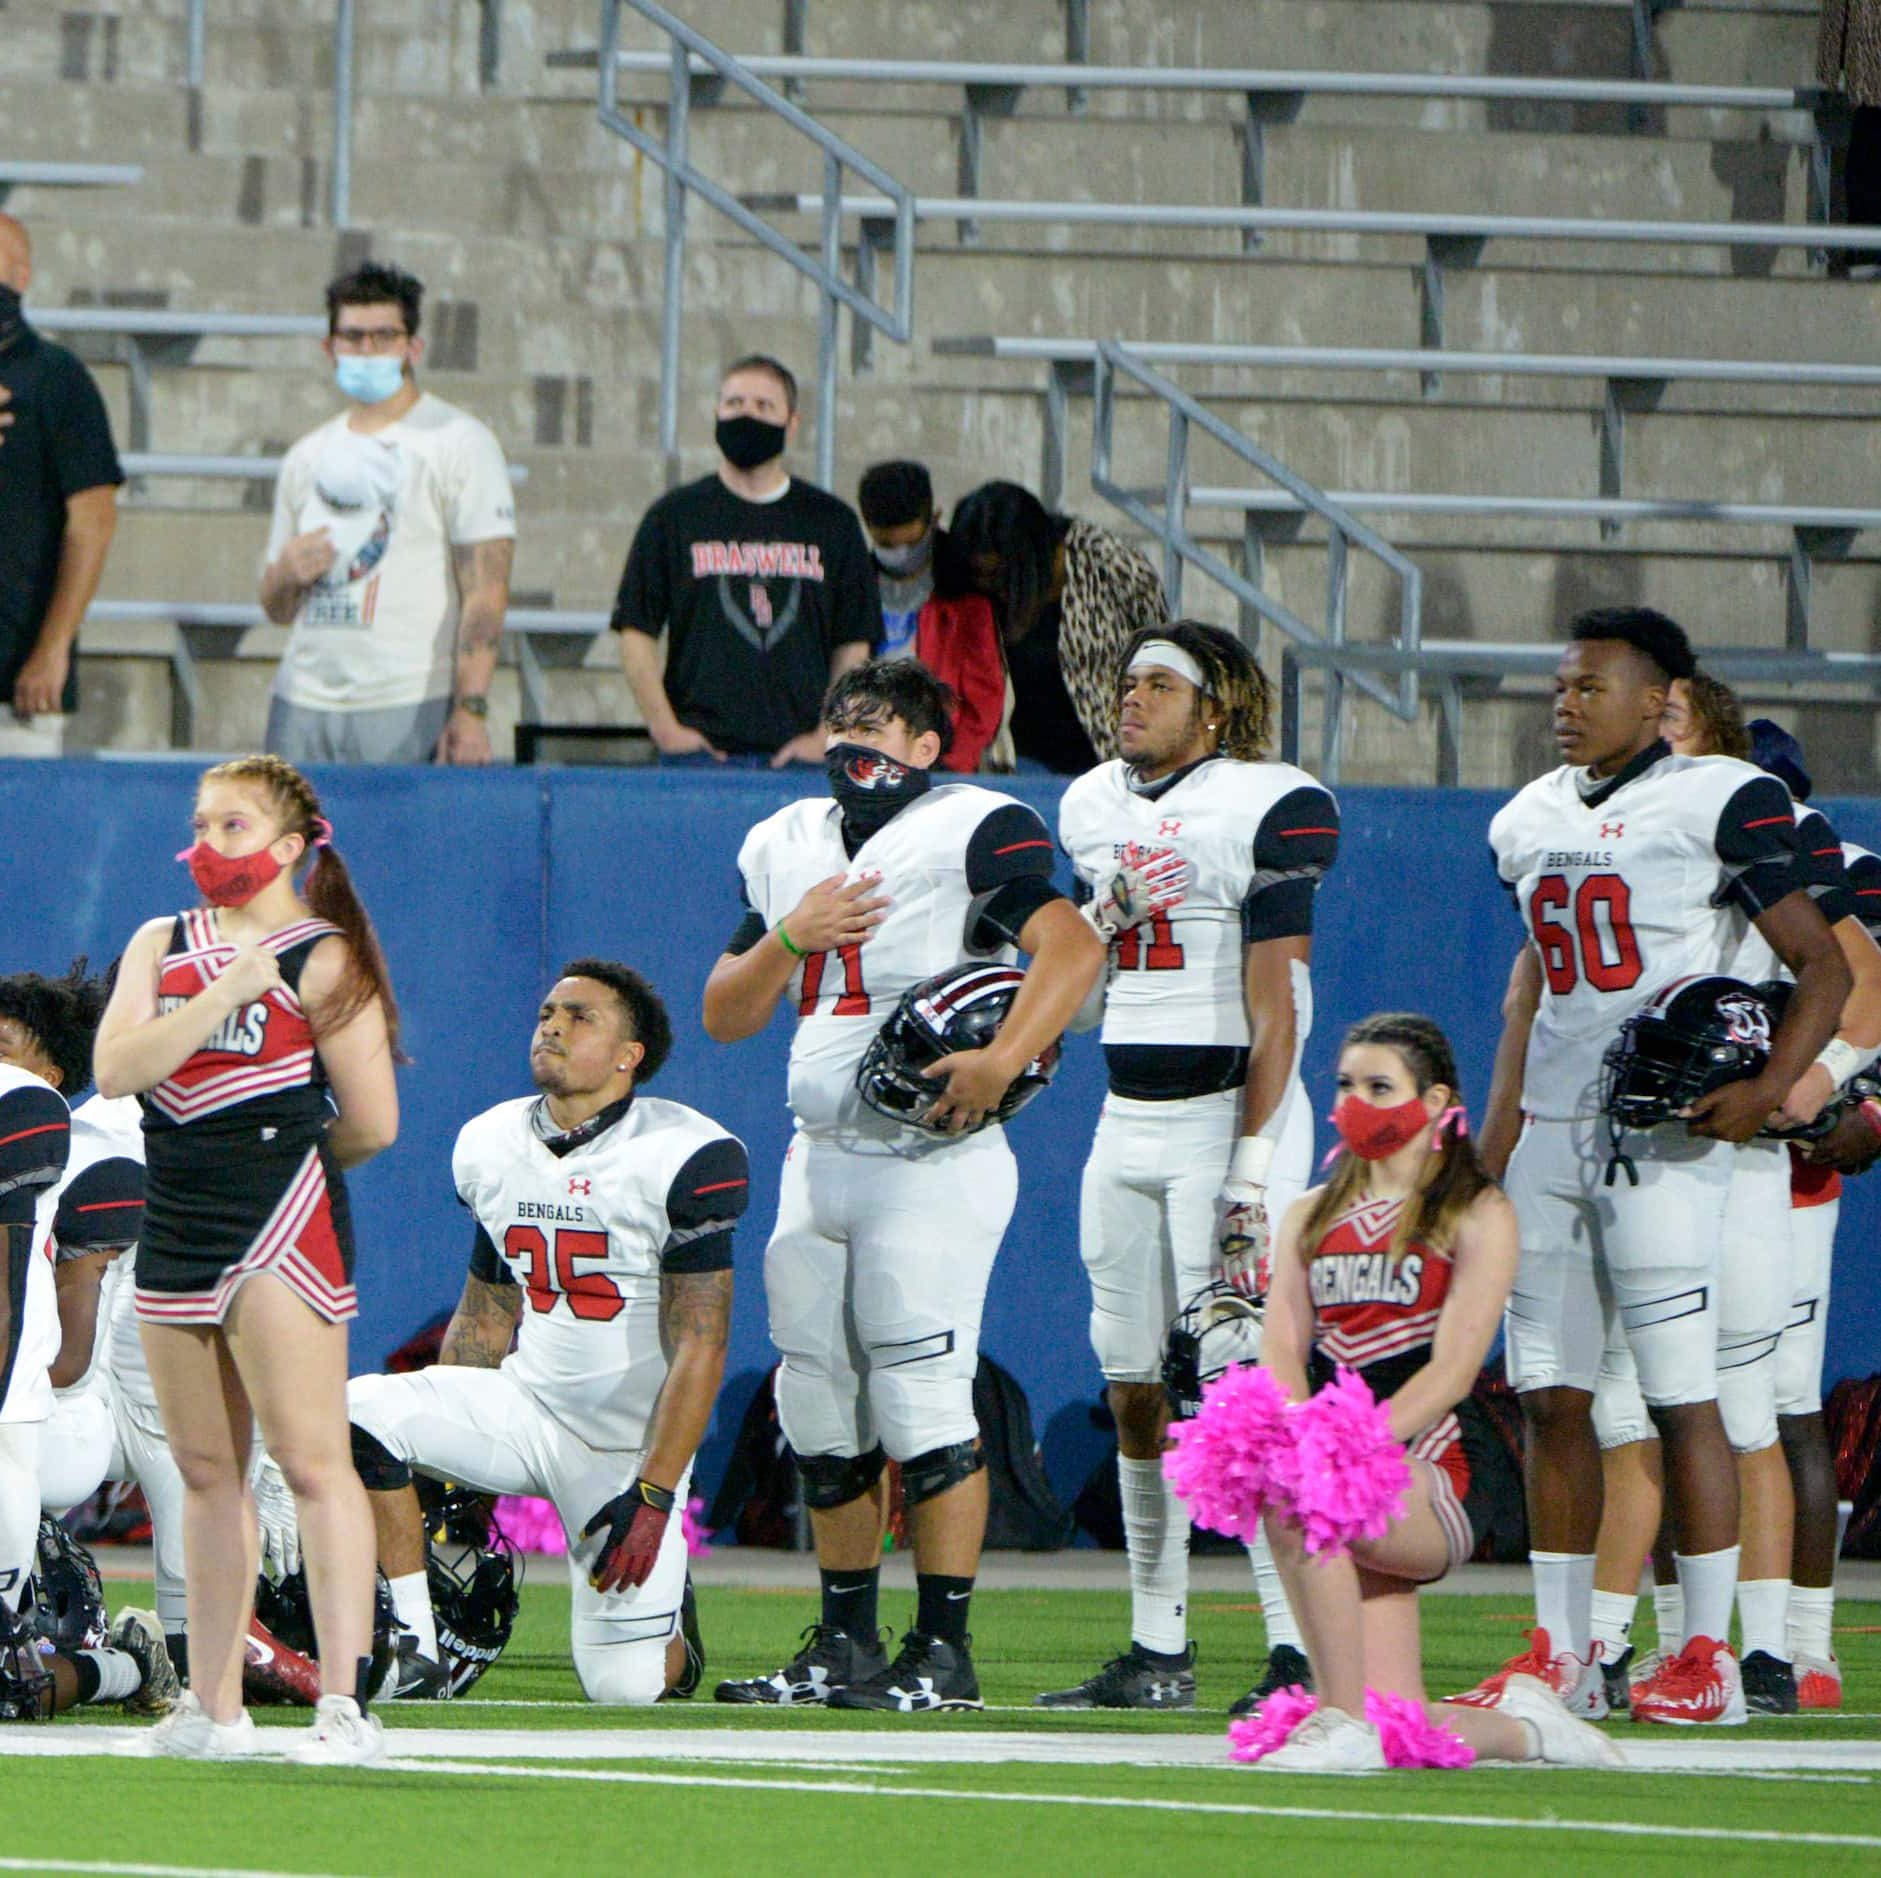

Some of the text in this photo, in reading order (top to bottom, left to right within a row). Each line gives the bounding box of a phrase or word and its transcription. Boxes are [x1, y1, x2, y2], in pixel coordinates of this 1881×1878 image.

[1547, 851, 1614, 868] BENGALS
[1530, 873, 1645, 996] 60
[517, 1202, 584, 1222] BENGALS
[503, 1224, 626, 1322] 35
[1309, 1252, 1424, 1308] BENGALS
[438, 1628, 502, 1662] Riddell
